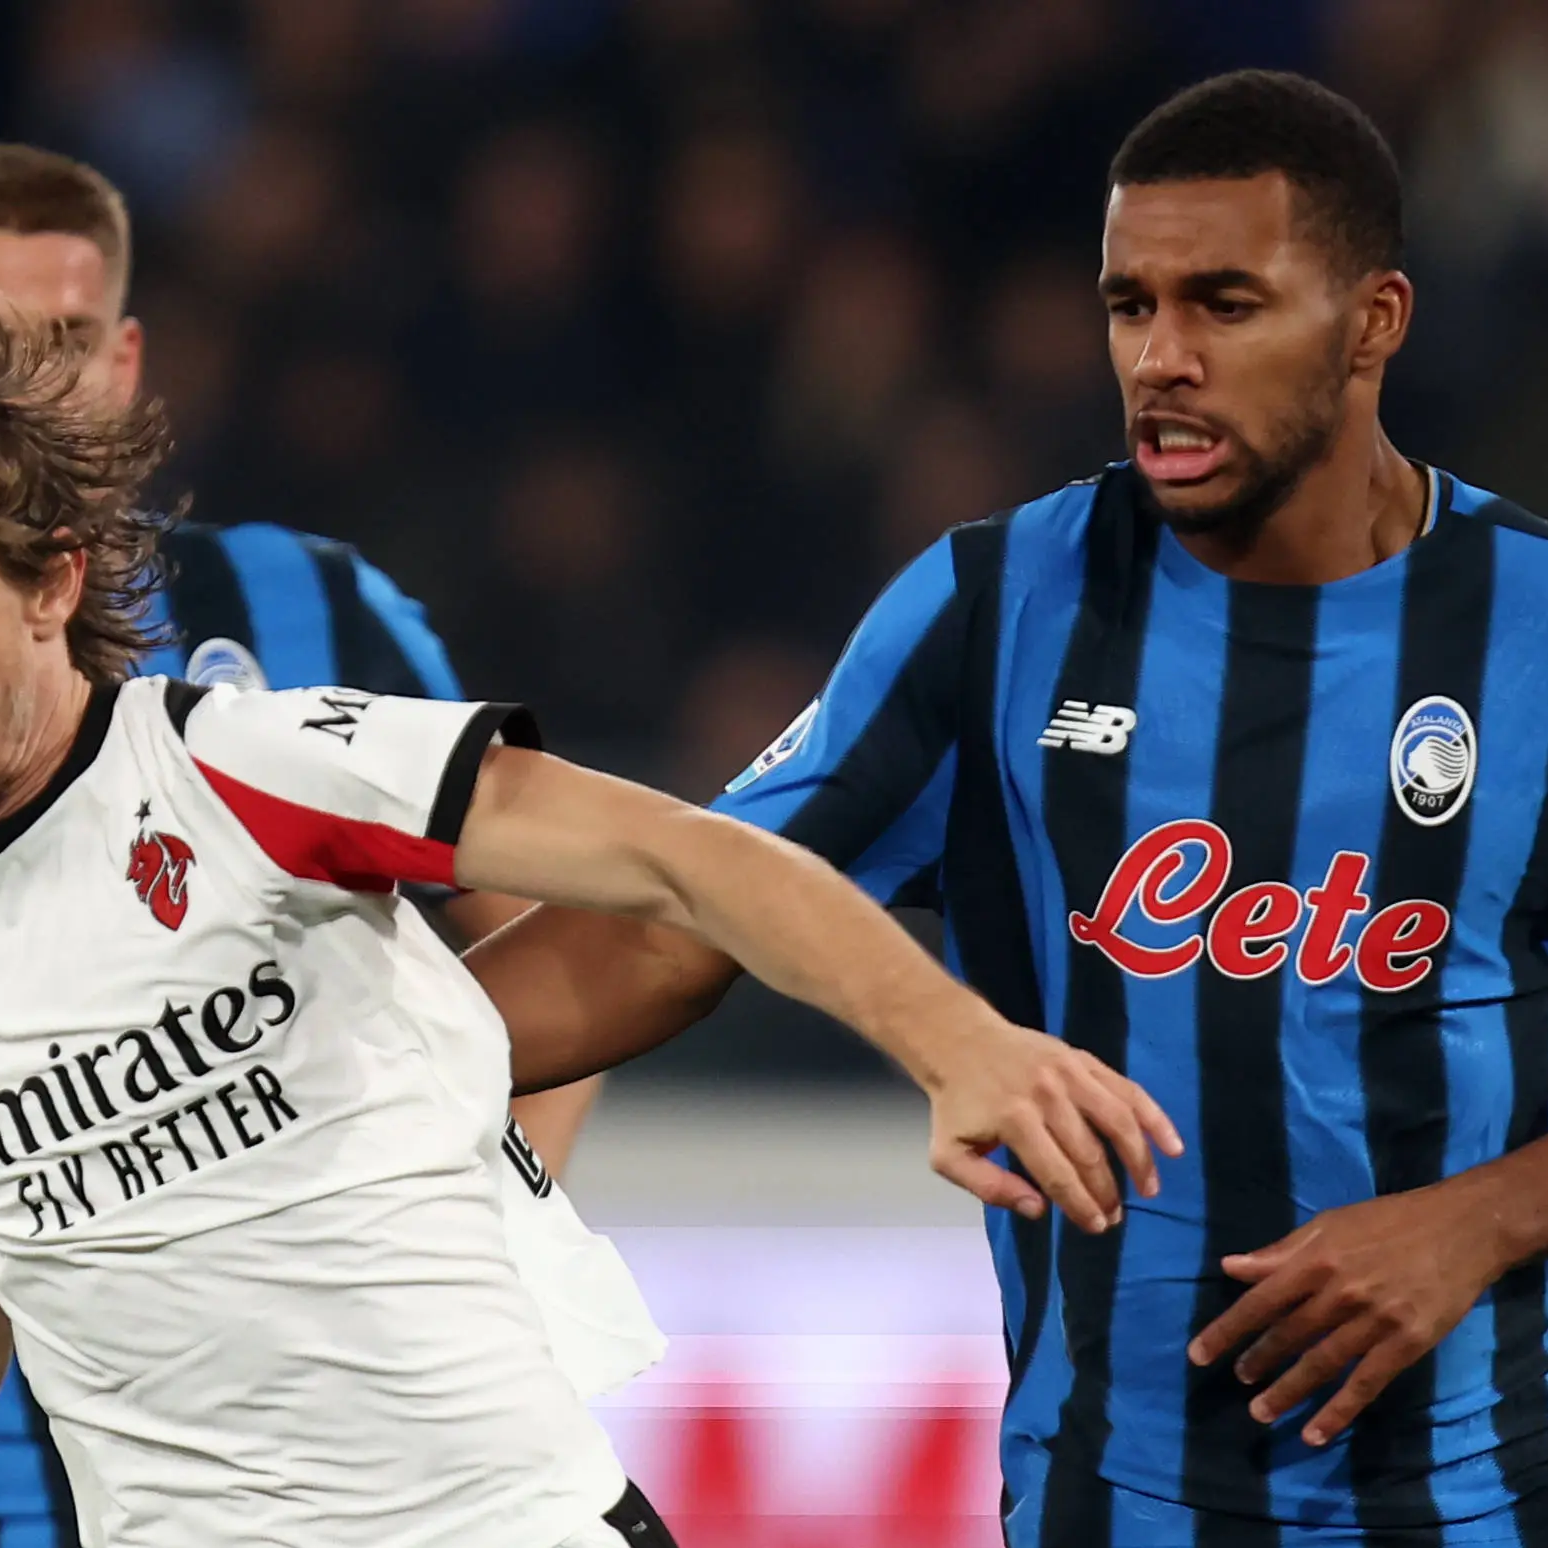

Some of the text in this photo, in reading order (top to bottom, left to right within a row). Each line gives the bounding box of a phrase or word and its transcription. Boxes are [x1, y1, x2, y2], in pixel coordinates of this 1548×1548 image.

[1036, 700, 1137, 755] NB
[1411, 714, 1464, 735] ATALANTA
[1412, 791, 1445, 808] 1907
[1069, 819, 1450, 992] Lete
[18, 1064, 300, 1238] FLY BETTER
